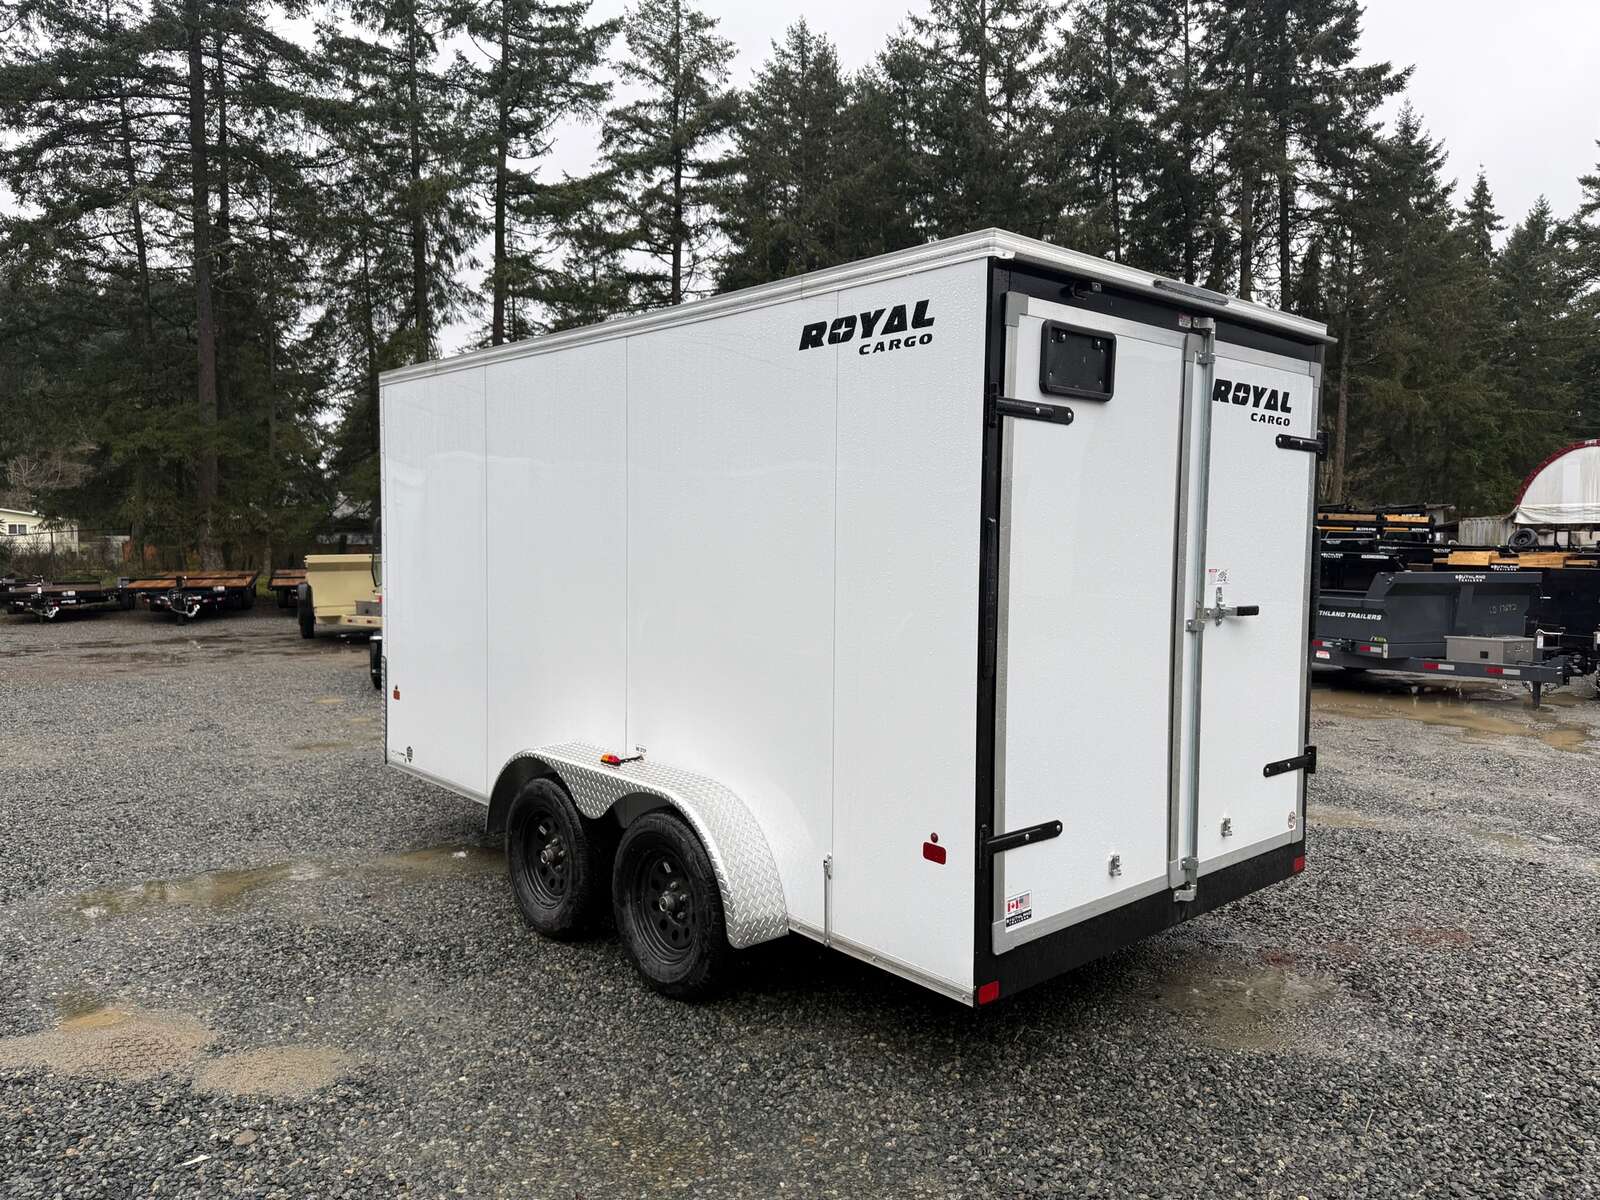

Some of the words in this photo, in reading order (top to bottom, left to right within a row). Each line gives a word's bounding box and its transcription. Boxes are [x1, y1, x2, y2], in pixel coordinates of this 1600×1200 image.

[799, 299, 935, 351] ROYAL
[858, 333, 933, 355] CARGO
[1212, 378, 1292, 414] ROYAL
[1250, 413, 1291, 426] CARGO
[1319, 610, 1346, 618] THLAND
[1347, 612, 1382, 621] TRAILERS
